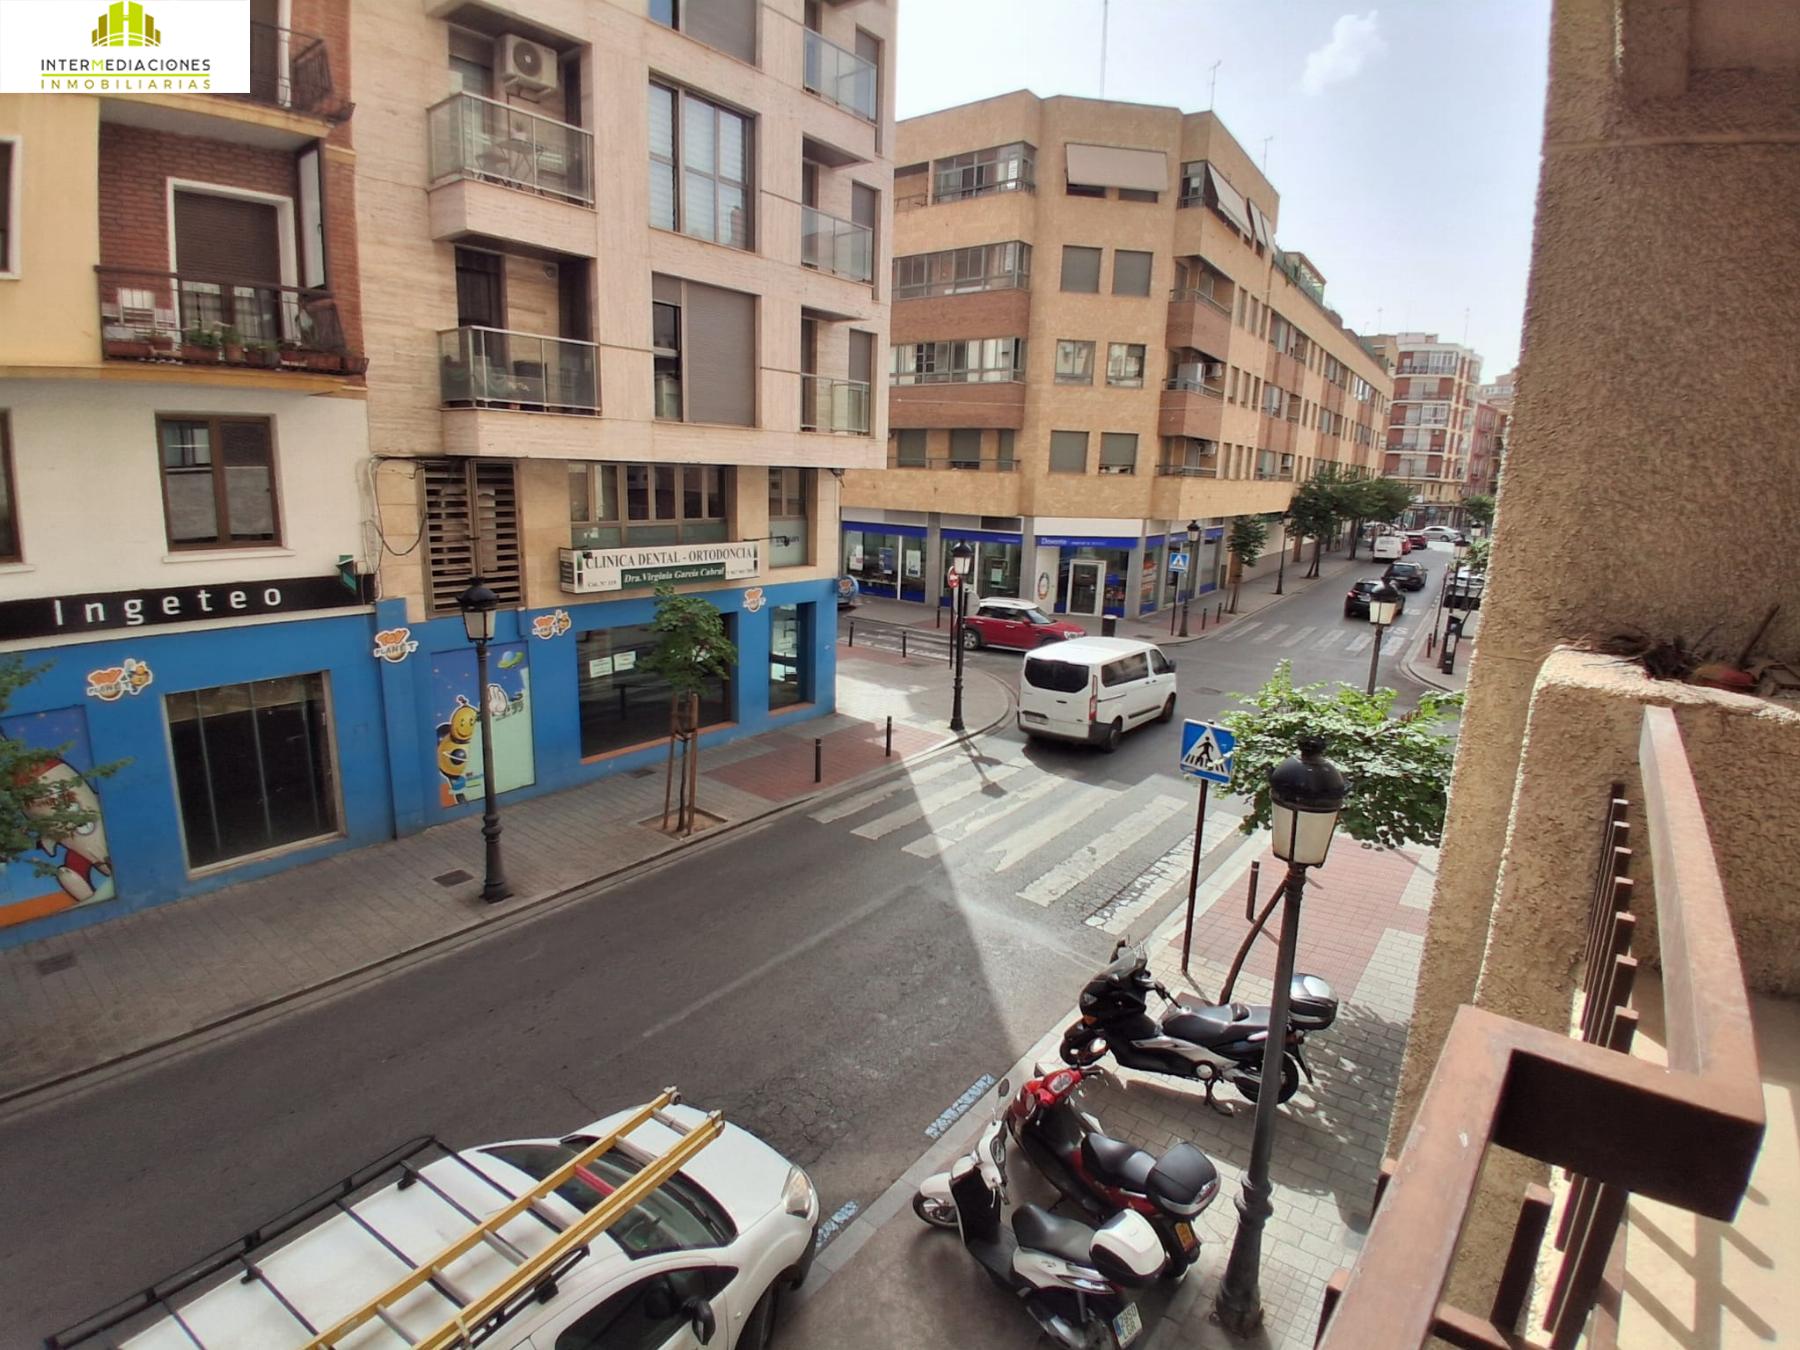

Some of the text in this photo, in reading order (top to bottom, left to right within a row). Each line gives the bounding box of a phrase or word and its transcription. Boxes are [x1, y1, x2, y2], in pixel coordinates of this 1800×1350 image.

[638, 551, 680, 566] DENTAL
[689, 547, 752, 561] ORTODONCIA
[700, 566, 725, 577] Cabral
[55, 587, 282, 626] Ingeteo
[377, 629, 408, 647] TOY
